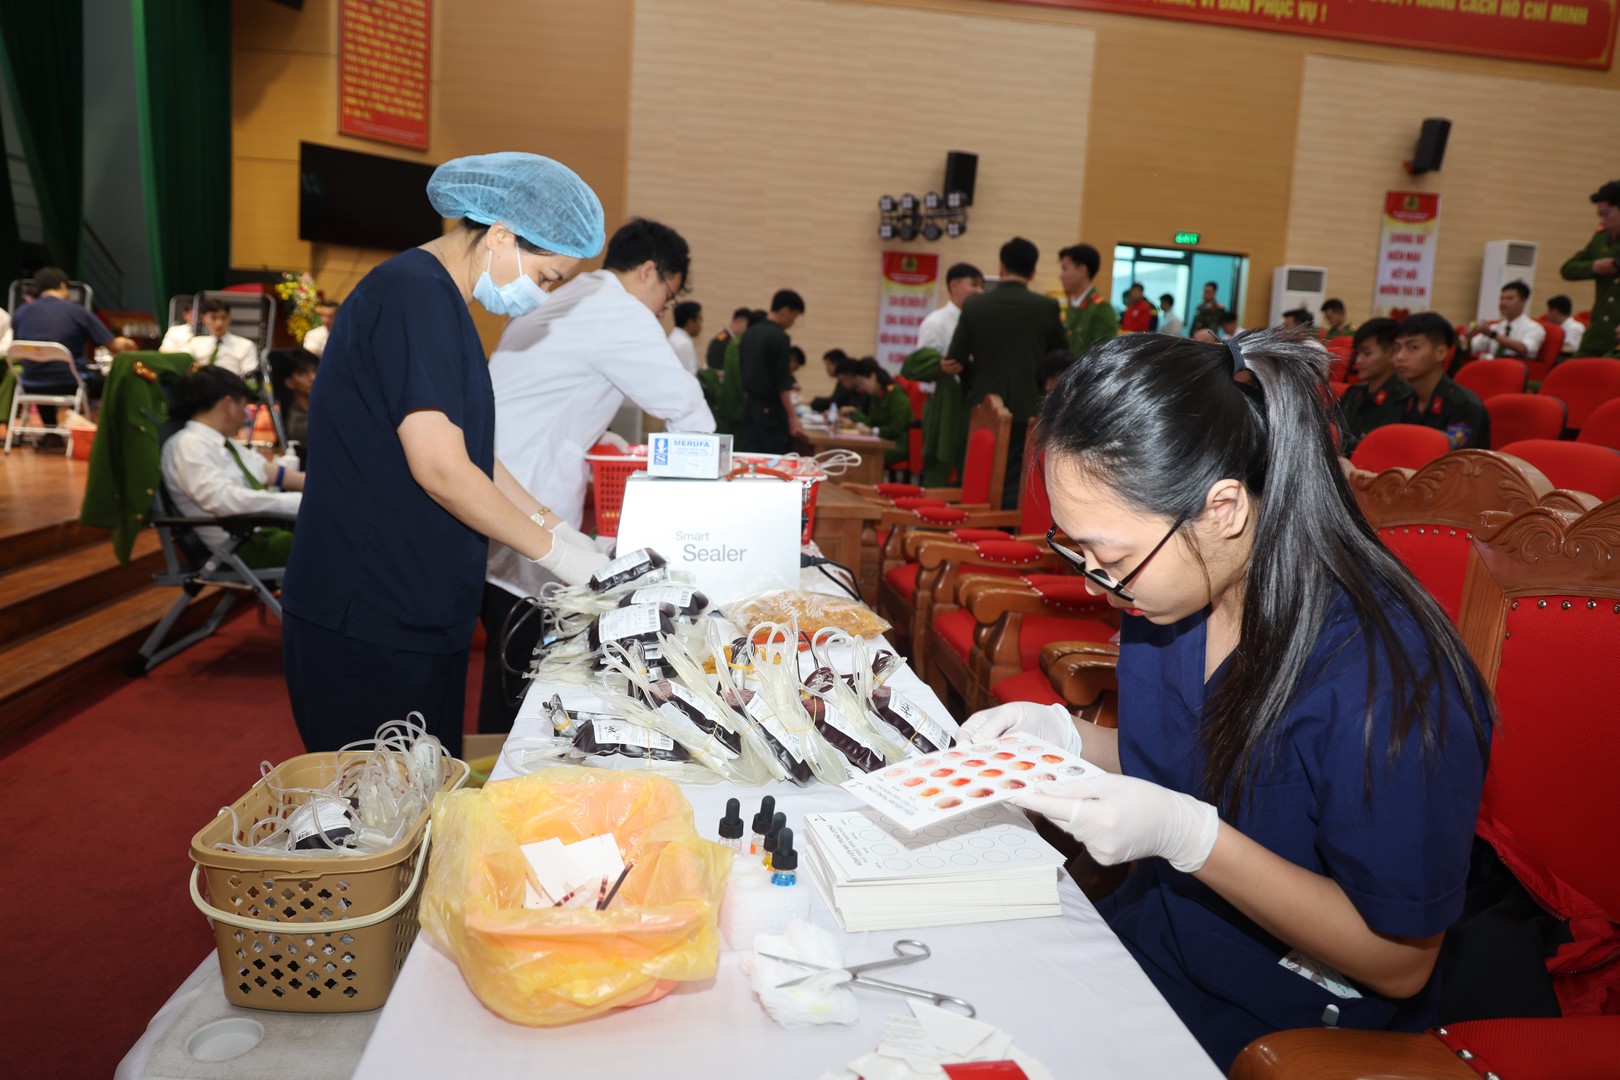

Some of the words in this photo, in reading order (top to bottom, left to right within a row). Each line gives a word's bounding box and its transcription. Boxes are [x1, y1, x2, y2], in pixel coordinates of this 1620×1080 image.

[673, 439, 710, 447] MERUFA
[675, 530, 709, 541] Smart
[682, 543, 747, 561] Sealer
